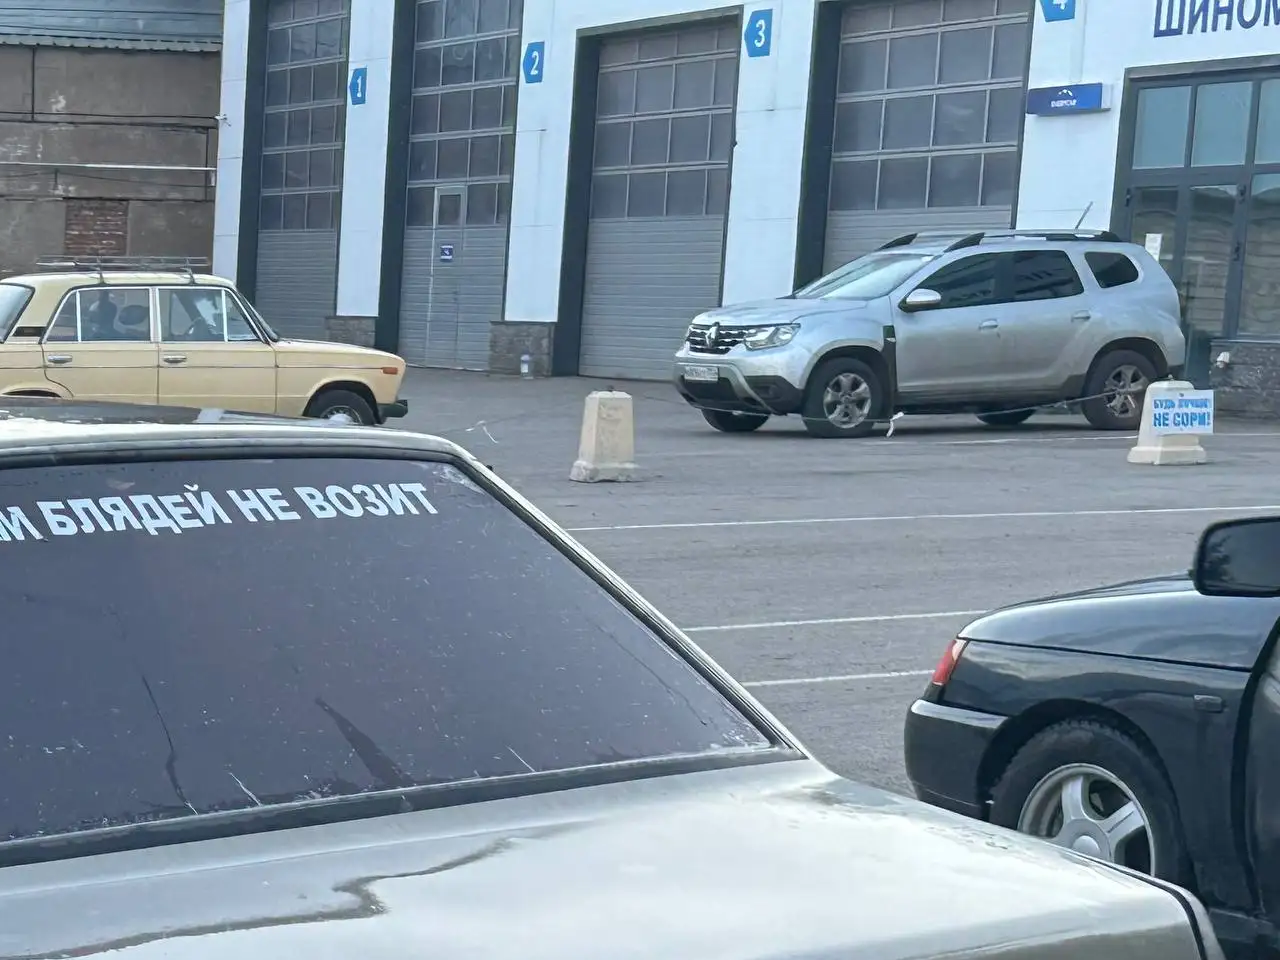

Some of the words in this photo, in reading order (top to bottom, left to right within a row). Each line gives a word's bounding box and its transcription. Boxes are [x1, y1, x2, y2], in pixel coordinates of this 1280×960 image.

[754, 19, 765, 48] 3
[529, 50, 540, 75] 2
[356, 75, 363, 98] 1
[1153, 412, 1169, 427] НЕ
[37, 484, 233, 536] БЛЯДЕЙ
[226, 488, 302, 523] НЕ
[293, 482, 439, 519] ВОЗИТ
